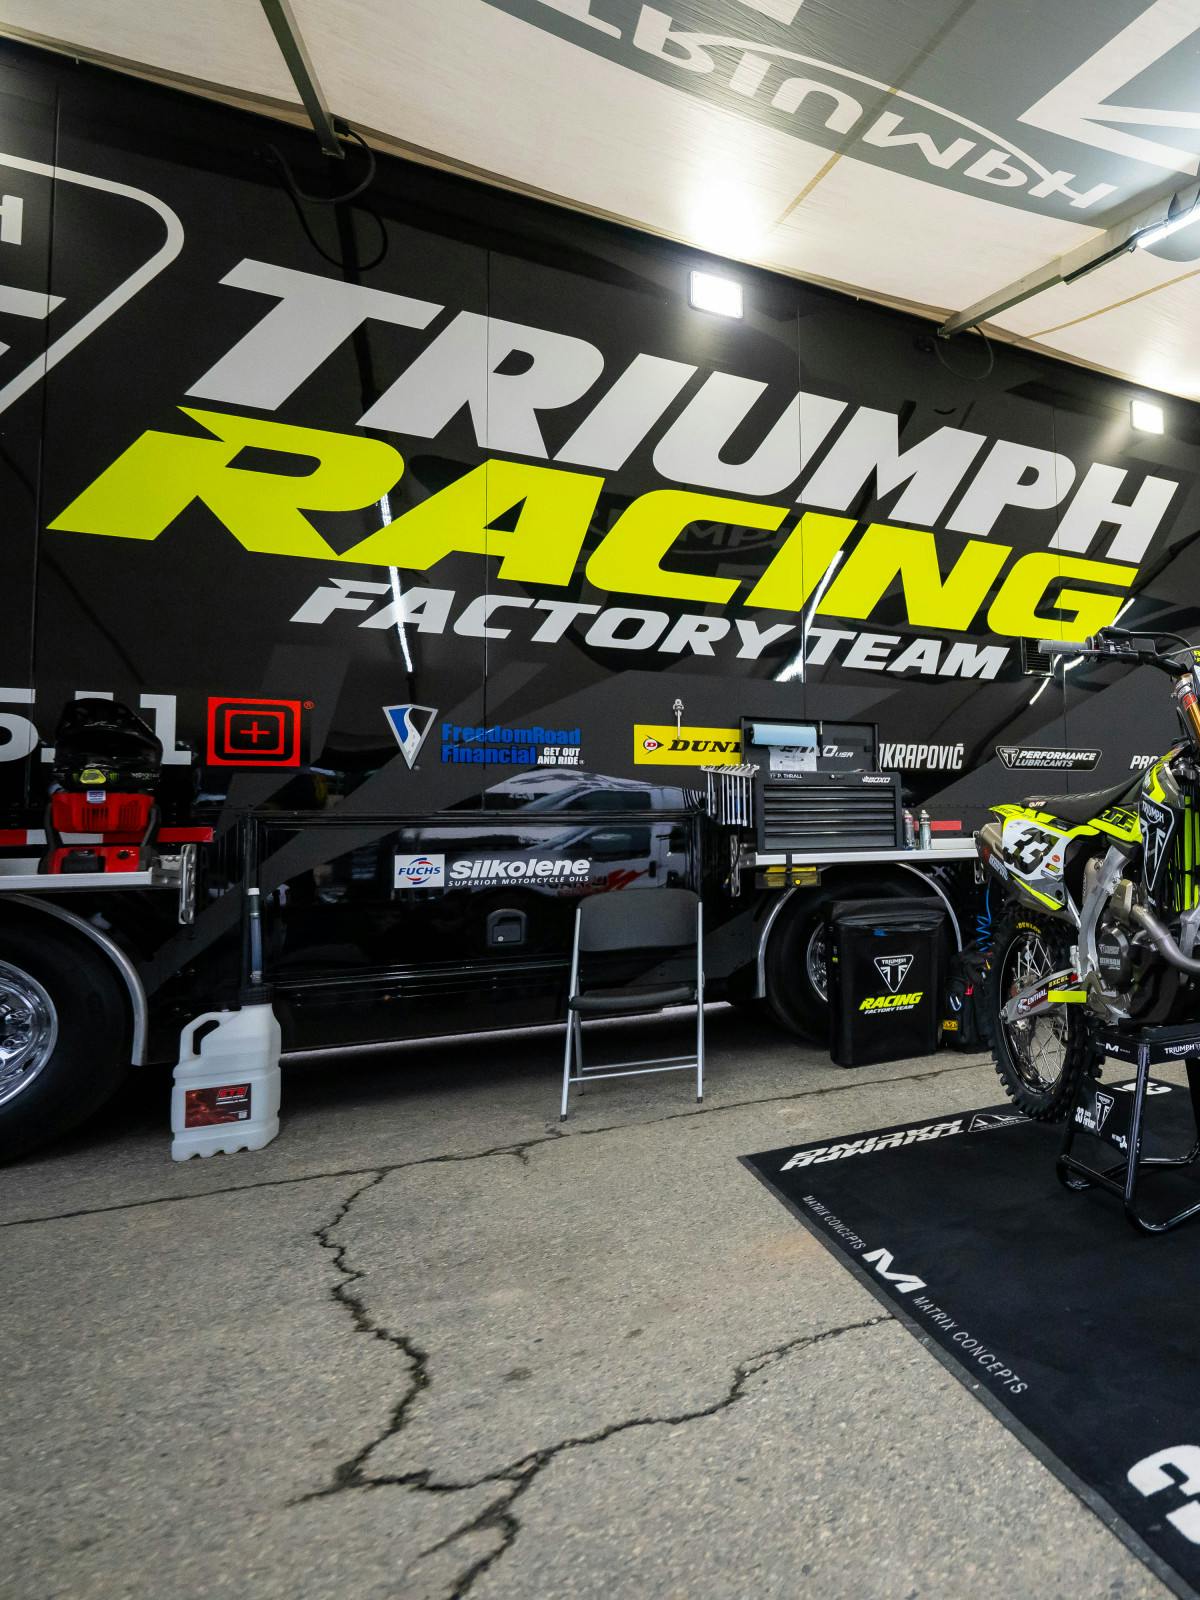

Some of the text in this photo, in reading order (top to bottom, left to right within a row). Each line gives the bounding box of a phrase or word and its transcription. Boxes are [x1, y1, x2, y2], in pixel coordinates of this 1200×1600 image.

[184, 258, 1180, 564] TRIUMPH
[46, 406, 1140, 643] RACING
[289, 577, 1010, 680] FACTORY TEAM
[441, 723, 582, 745] FreedomRoad
[441, 745, 536, 765] Financial
[537, 756, 579, 765] AND RIDE
[543, 747, 580, 756] GET OUT
[1018, 750, 1097, 761] PERFORMANCE
[1015, 759, 1073, 768] LUBRICANTS
[398, 867, 442, 875] FUCHS
[450, 859, 591, 879] Silkolene
[448, 879, 498, 887] SUPERIOR
[501, 877, 566, 885] MOTORCYCLE
[858, 992, 924, 1011] RACING
[864, 1006, 894, 1014] FACTORY
[1164, 1043, 1196, 1056] TRIUMPH
[824, 1215, 867, 1250] CONCEPTS
[911, 1296, 1029, 1394] MATRIX CONCEPTS
